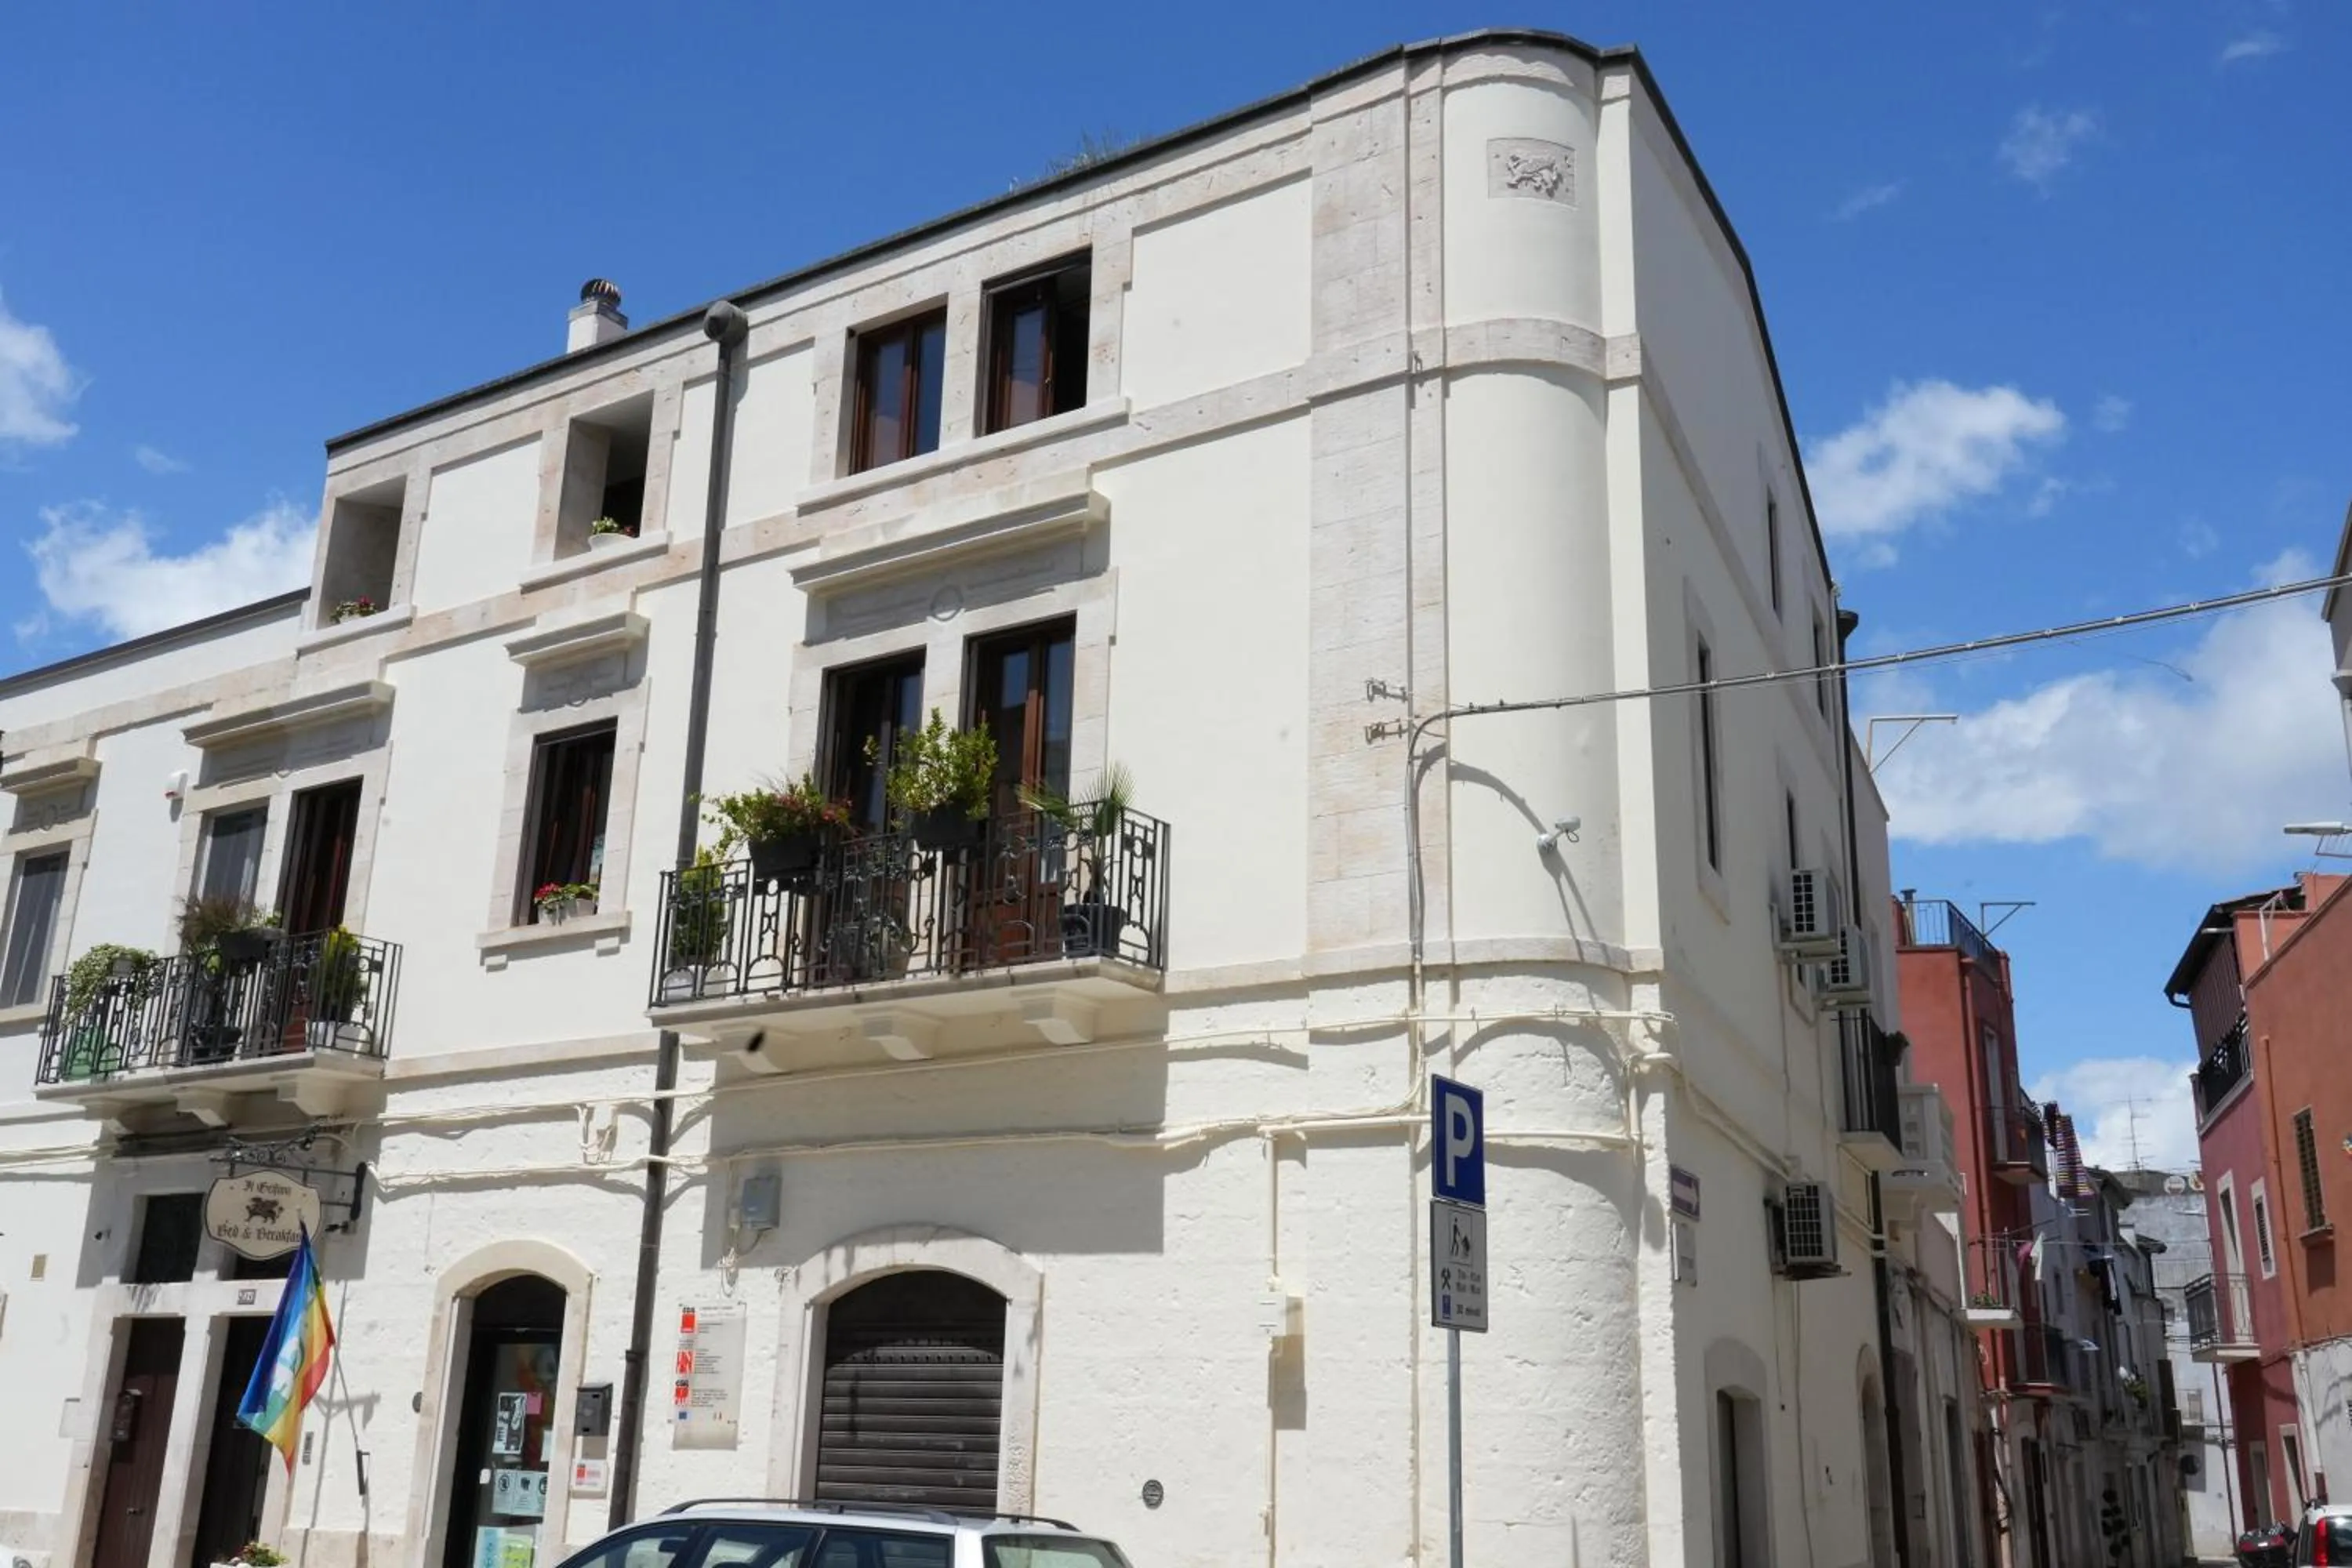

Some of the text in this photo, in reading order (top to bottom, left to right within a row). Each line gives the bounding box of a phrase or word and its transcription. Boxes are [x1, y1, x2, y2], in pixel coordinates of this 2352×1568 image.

[1445, 1091, 1475, 1188] P
[216, 1222, 301, 1243] Bed & Breakfas
